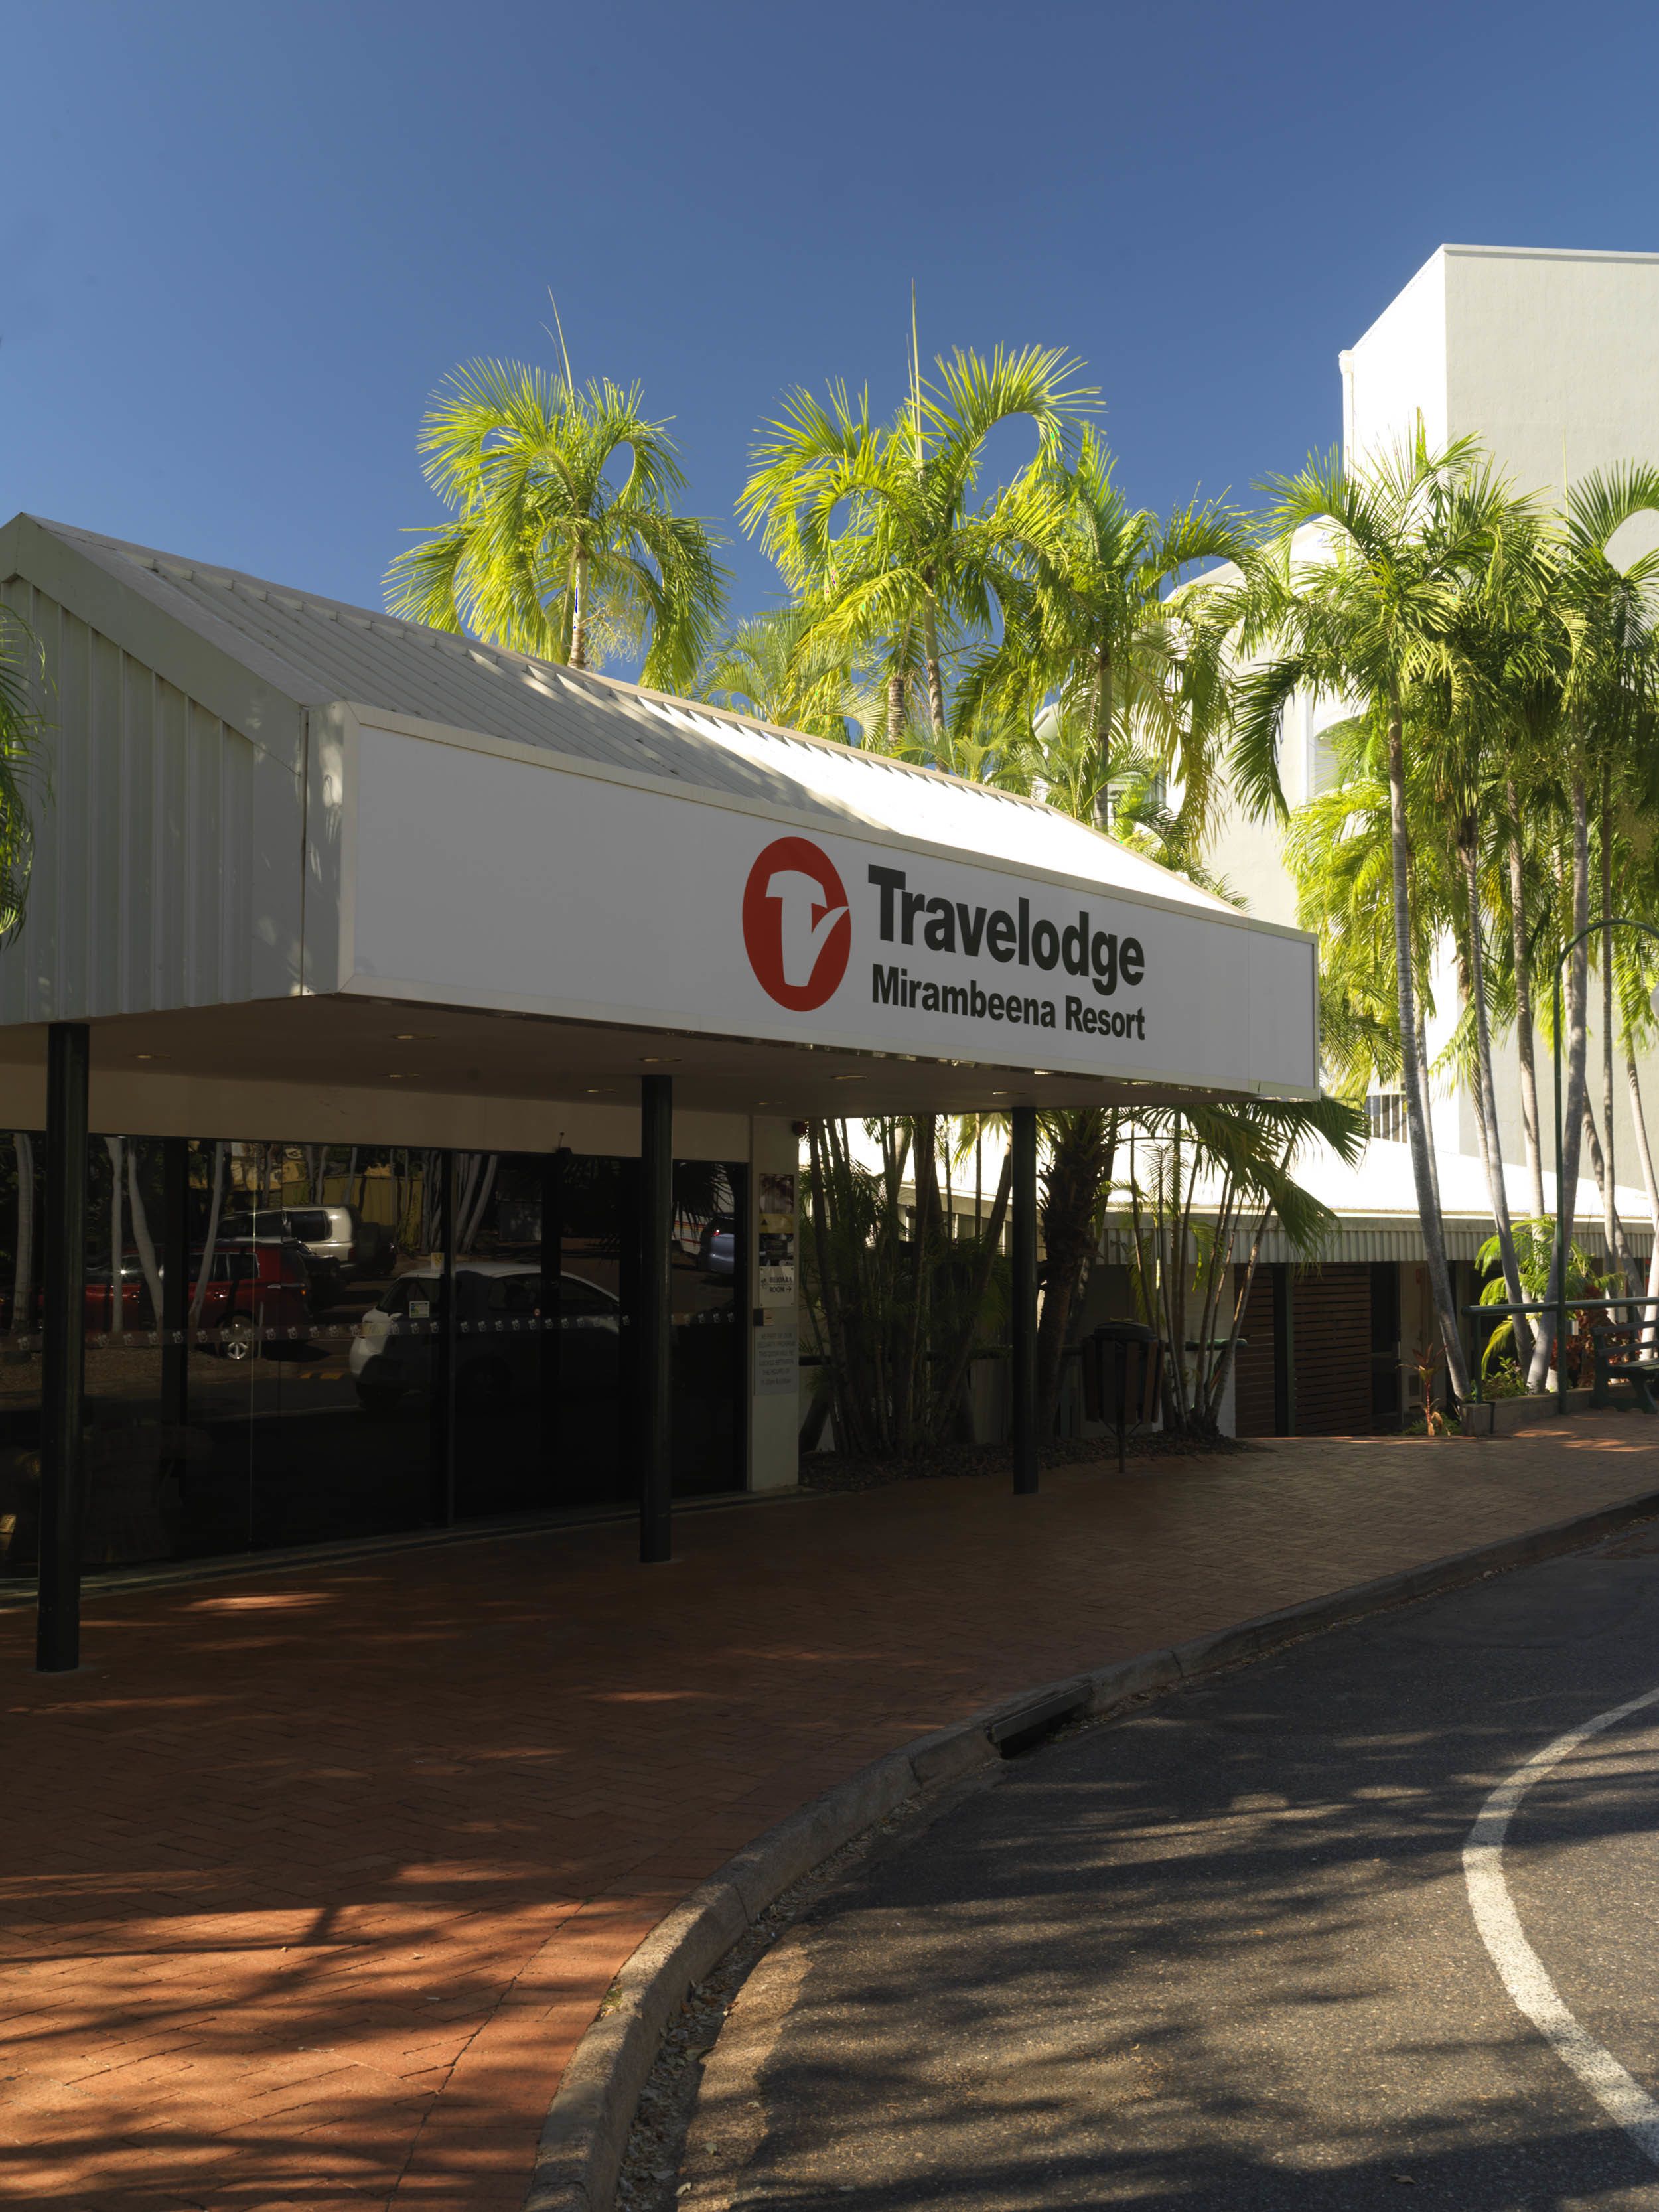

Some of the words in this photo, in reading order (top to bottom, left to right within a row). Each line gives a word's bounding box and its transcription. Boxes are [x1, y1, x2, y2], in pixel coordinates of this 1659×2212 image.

[868, 864, 1145, 996] Travelodge
[872, 963, 1056, 1029] Mirambeena
[1065, 995, 1146, 1041] Resort
